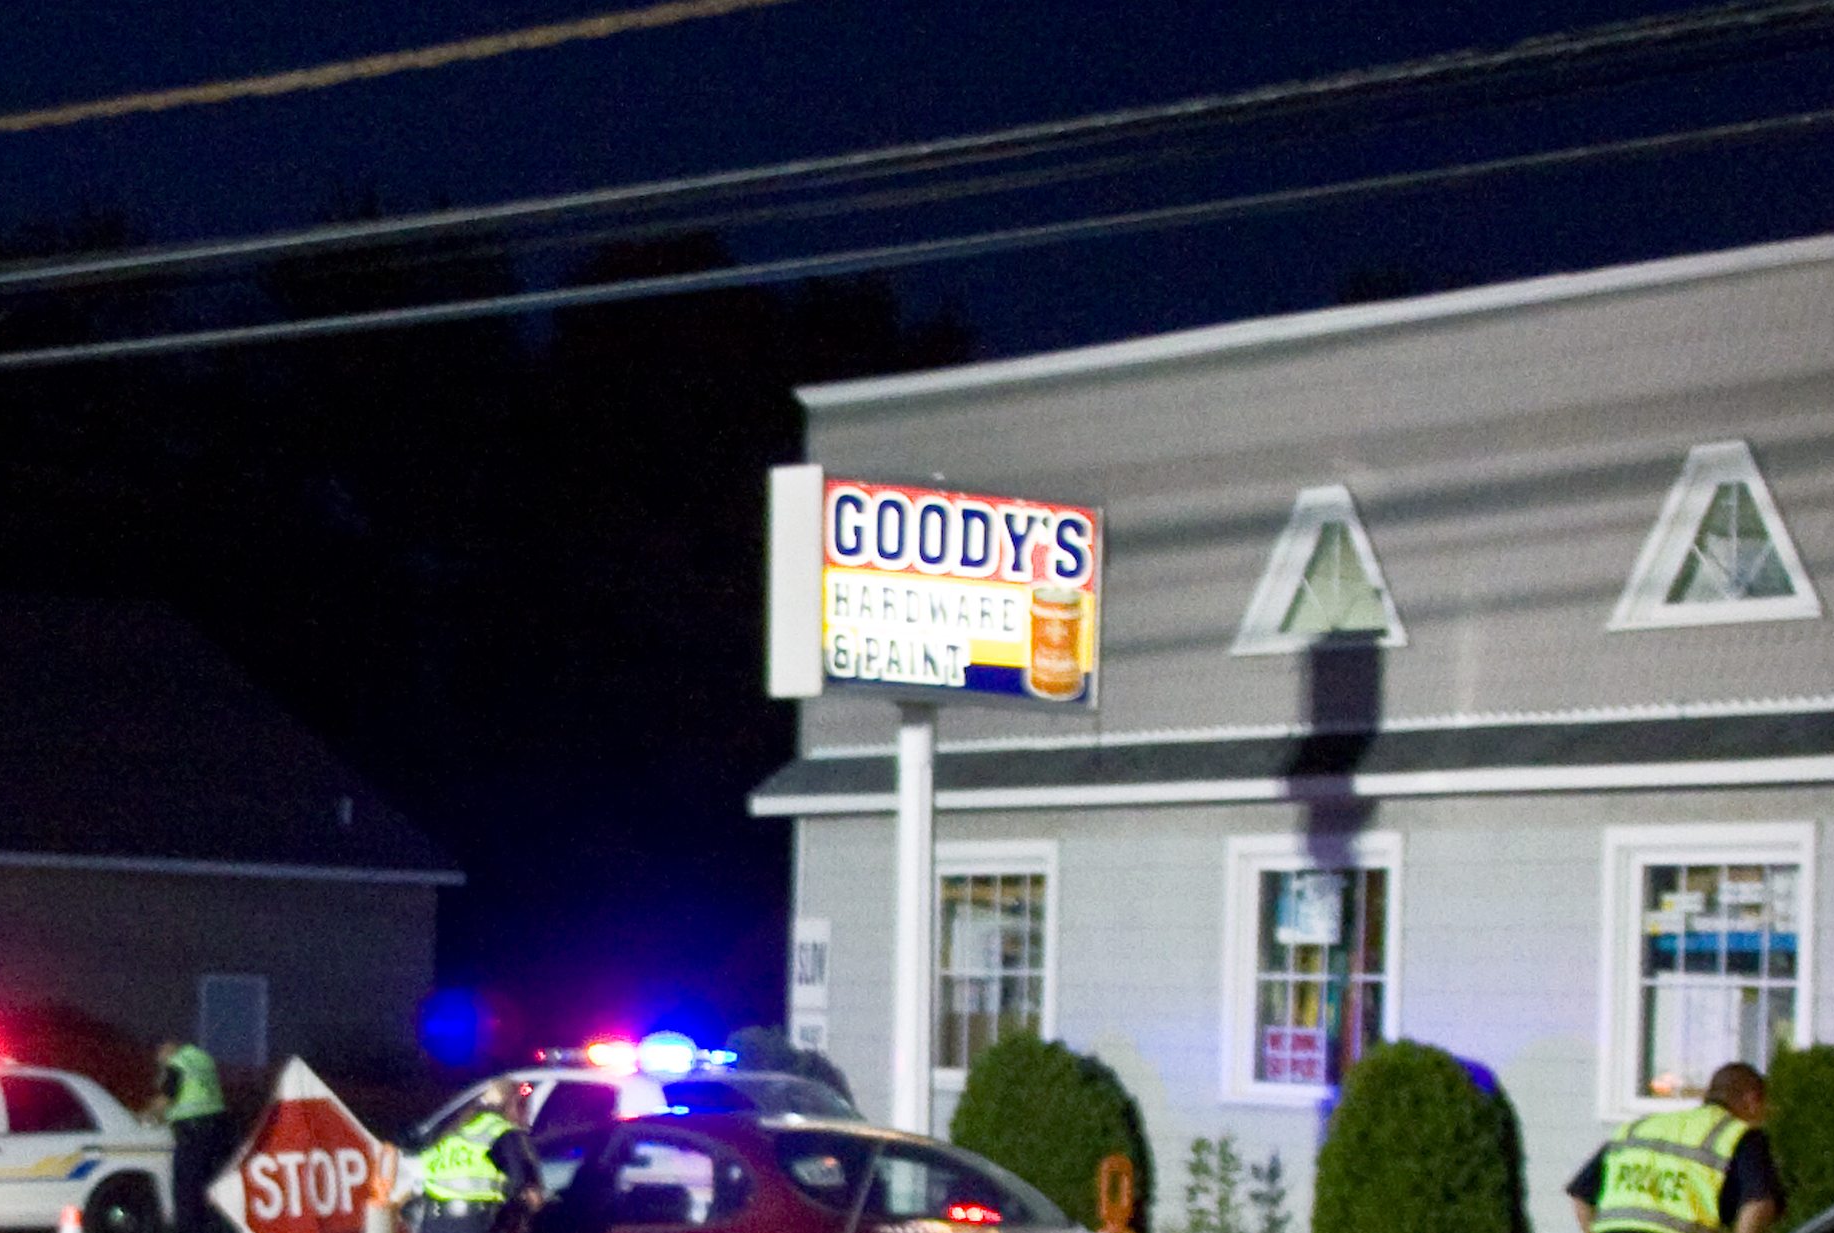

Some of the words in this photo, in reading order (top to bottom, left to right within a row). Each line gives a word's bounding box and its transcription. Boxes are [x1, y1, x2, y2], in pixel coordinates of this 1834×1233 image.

[834, 493, 1089, 581] GOODY'S
[834, 581, 1018, 633] HARDWARE
[248, 1147, 368, 1221] STOP
